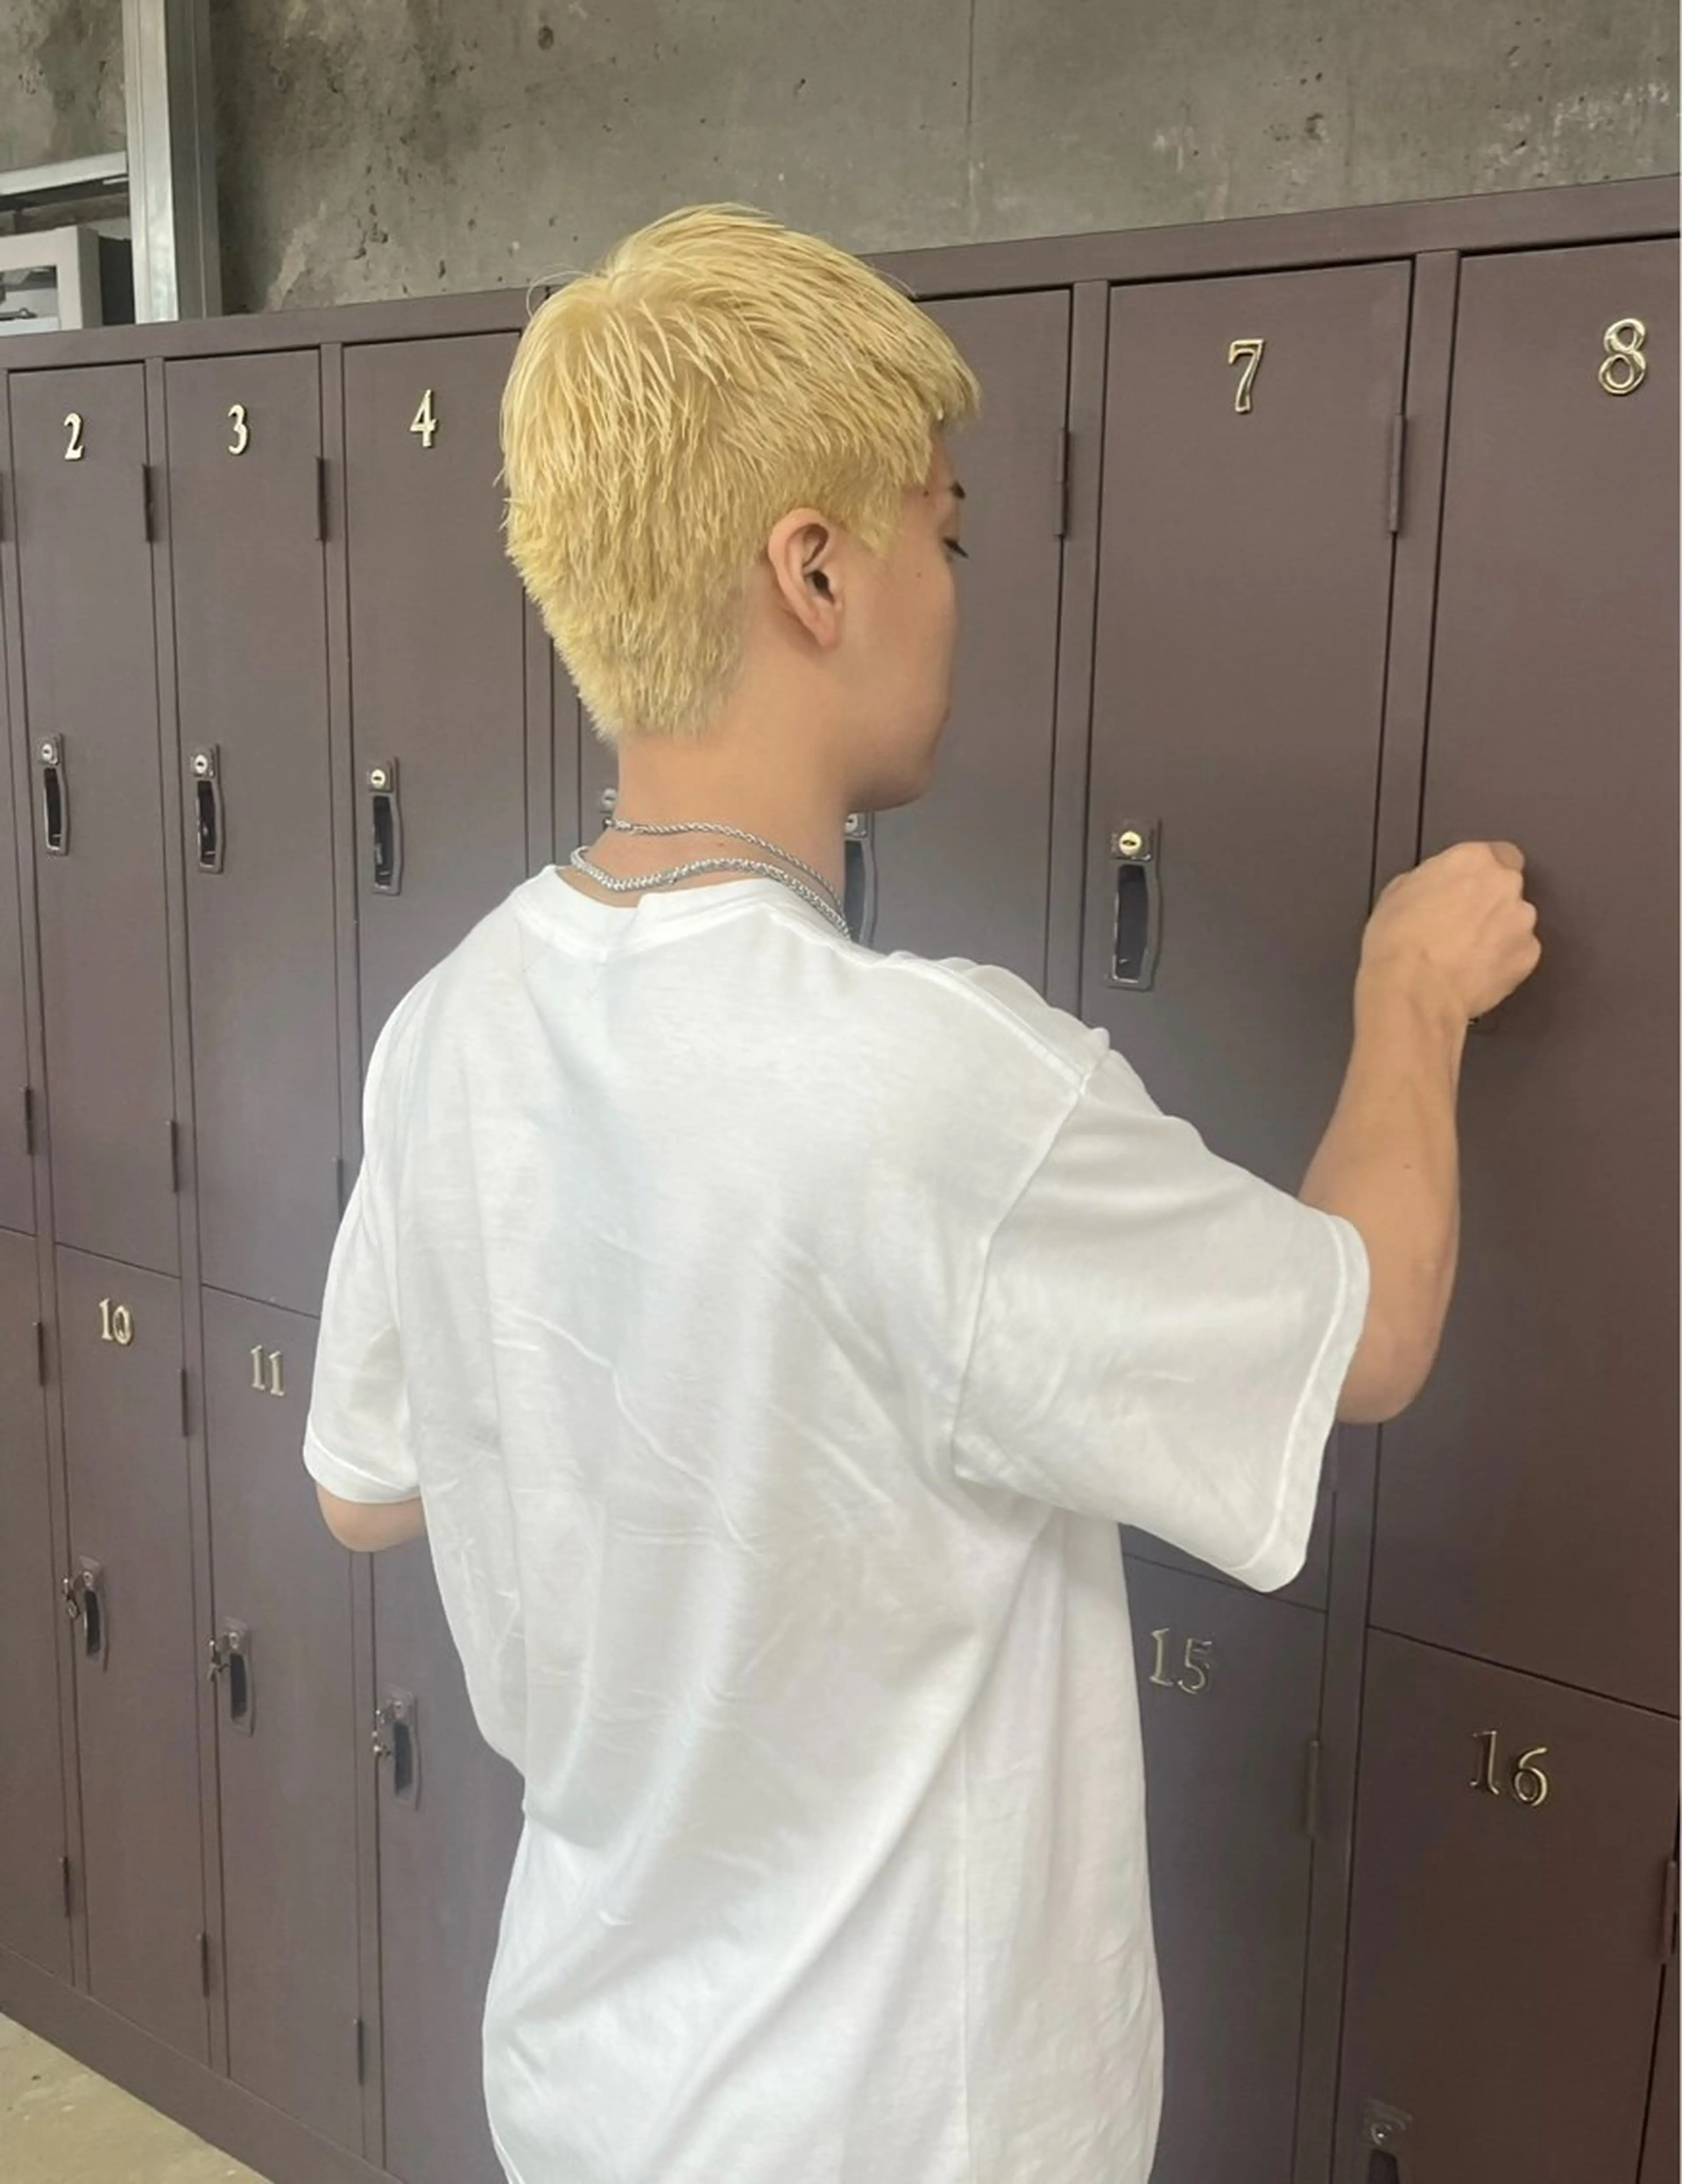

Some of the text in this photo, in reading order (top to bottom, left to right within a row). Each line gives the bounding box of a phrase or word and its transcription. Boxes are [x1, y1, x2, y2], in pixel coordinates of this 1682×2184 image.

[1228, 338, 1265, 413] 7
[1598, 318, 1647, 395] 8
[64, 413, 84, 461] 2
[228, 404, 248, 455] 3
[410, 389, 436, 448] 4
[99, 1297, 133, 1345] 10
[250, 1345, 285, 1396] 11
[1148, 1628, 1213, 1694] 15
[1469, 1729, 1548, 1807] 16
